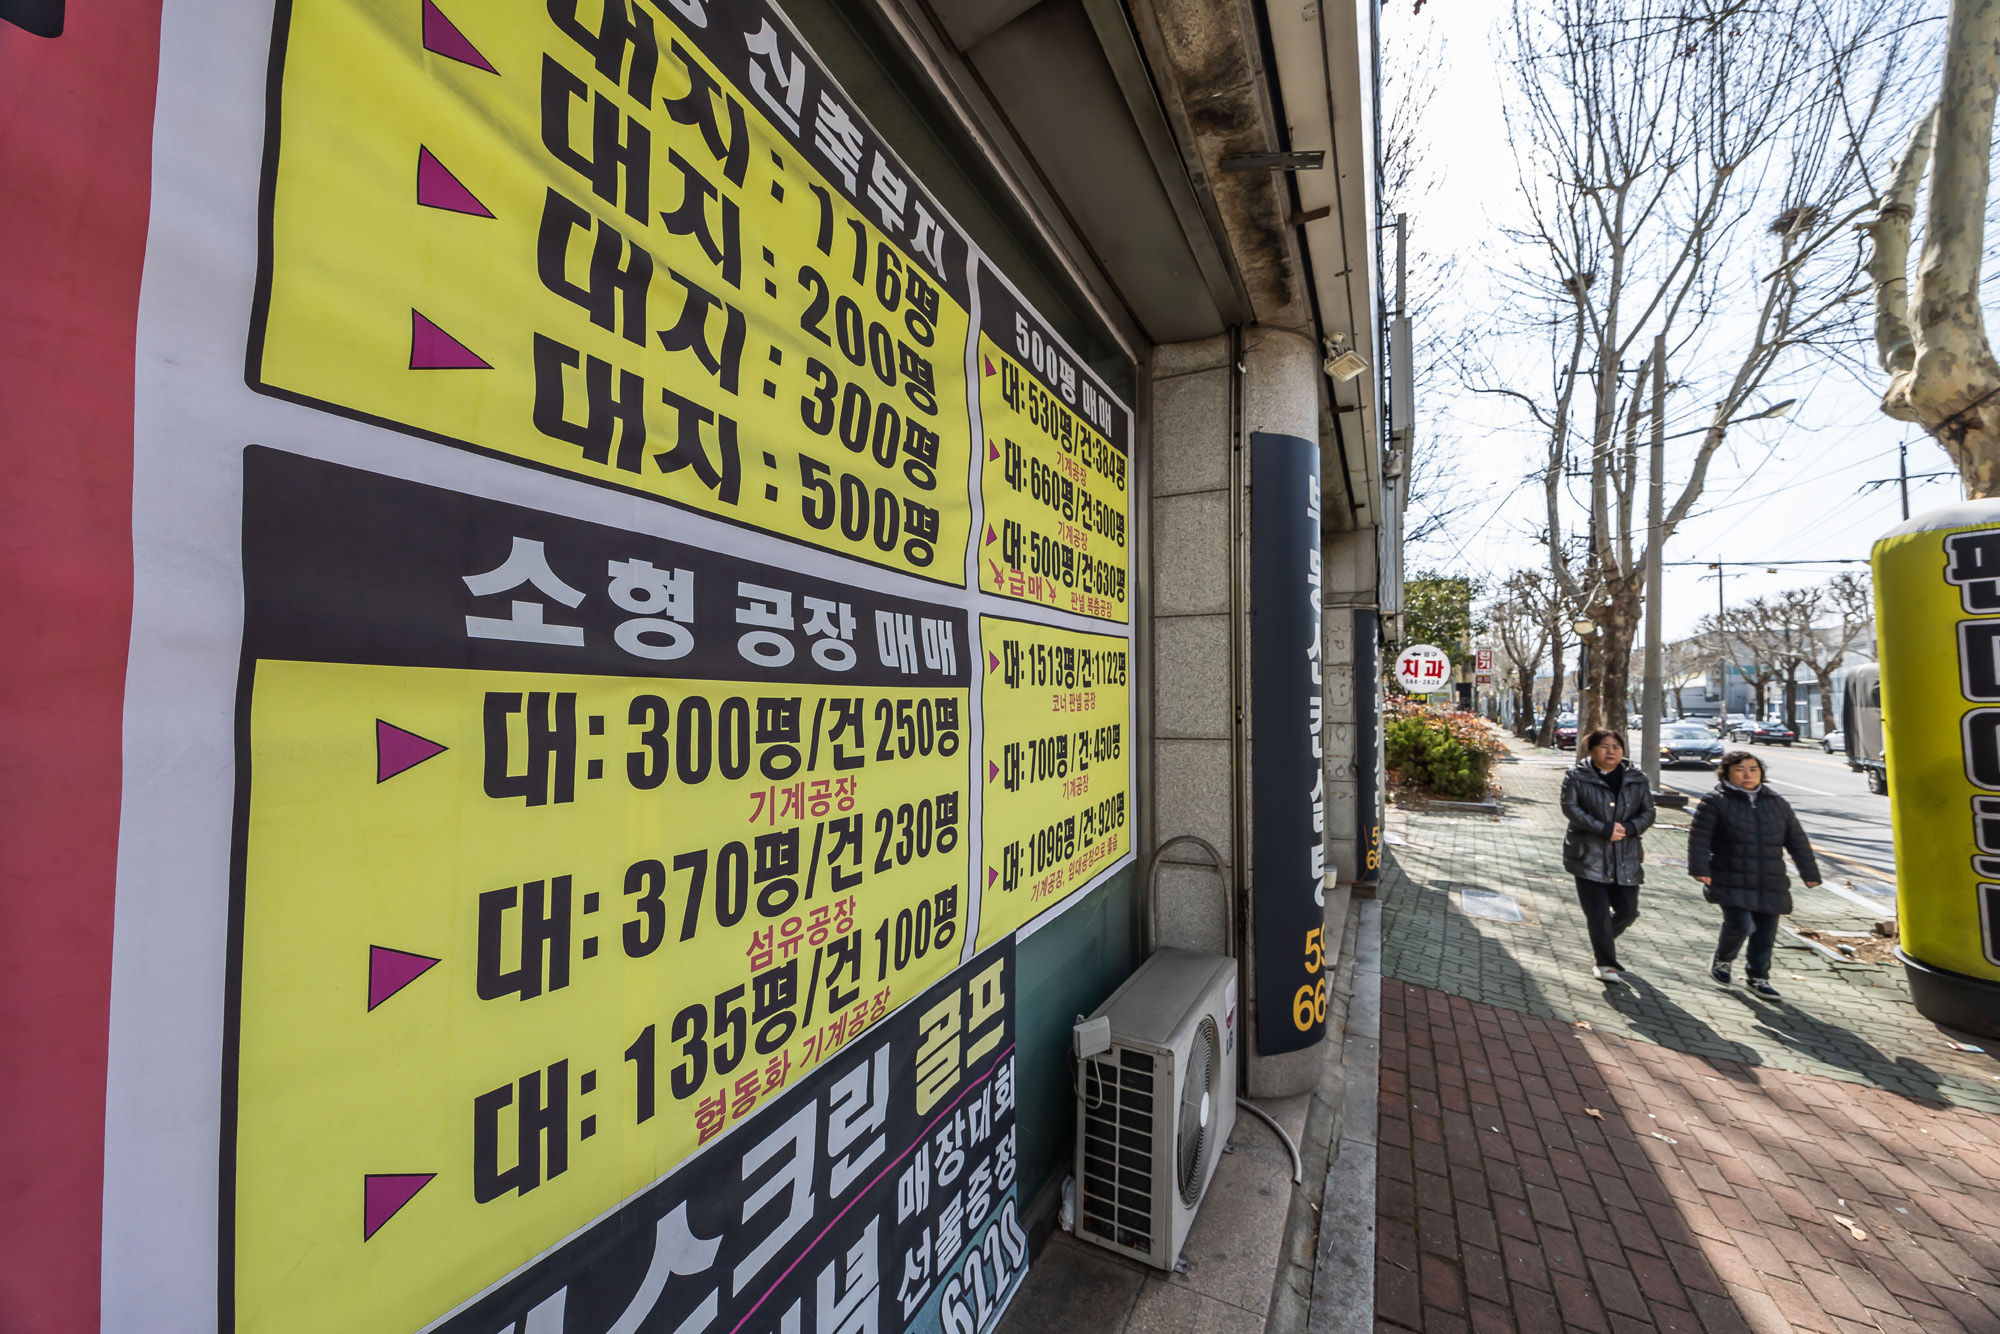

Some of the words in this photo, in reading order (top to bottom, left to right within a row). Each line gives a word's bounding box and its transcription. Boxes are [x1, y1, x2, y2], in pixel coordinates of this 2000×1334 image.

[1016, 311, 1076, 405] 500평
[1082, 379, 1112, 438] 매매
[1056, 451, 1087, 487] 기계공장
[1057, 521, 1088, 552] 기계공장
[461, 536, 695, 660] 소형
[736, 581, 857, 672] 공장
[875, 610, 958, 676] 매매
[1008, 568, 1043, 602] 급매
[1402, 658, 1444, 679] 치과
[748, 775, 857, 826] 기계공장
[1062, 773, 1089, 800] 기계공장
[746, 895, 856, 974] 섬유공장
[915, 957, 1005, 1116] 골프
[694, 1049, 791, 1147] 협동화
[800, 986, 891, 1068] 기계공장
